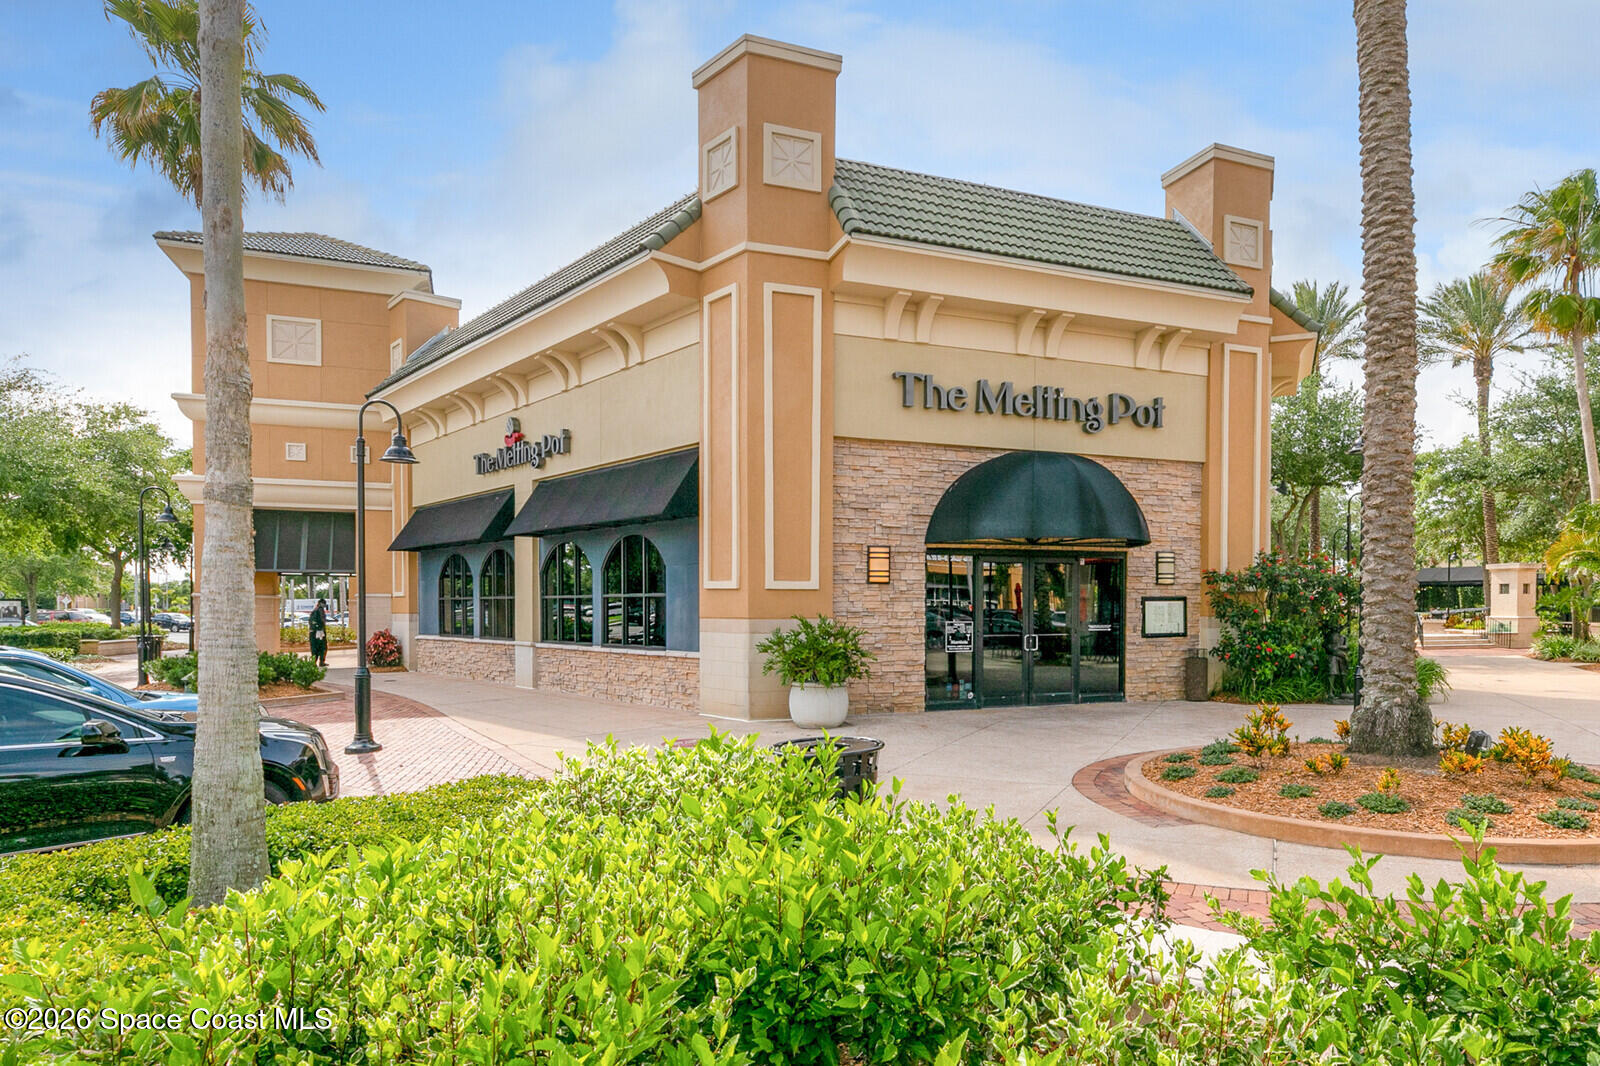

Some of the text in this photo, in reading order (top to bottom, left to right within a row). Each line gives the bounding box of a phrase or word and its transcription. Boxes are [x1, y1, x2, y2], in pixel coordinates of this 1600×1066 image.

[892, 371, 1166, 434] The Melting Pot
[473, 428, 571, 475] The Melting Pot
